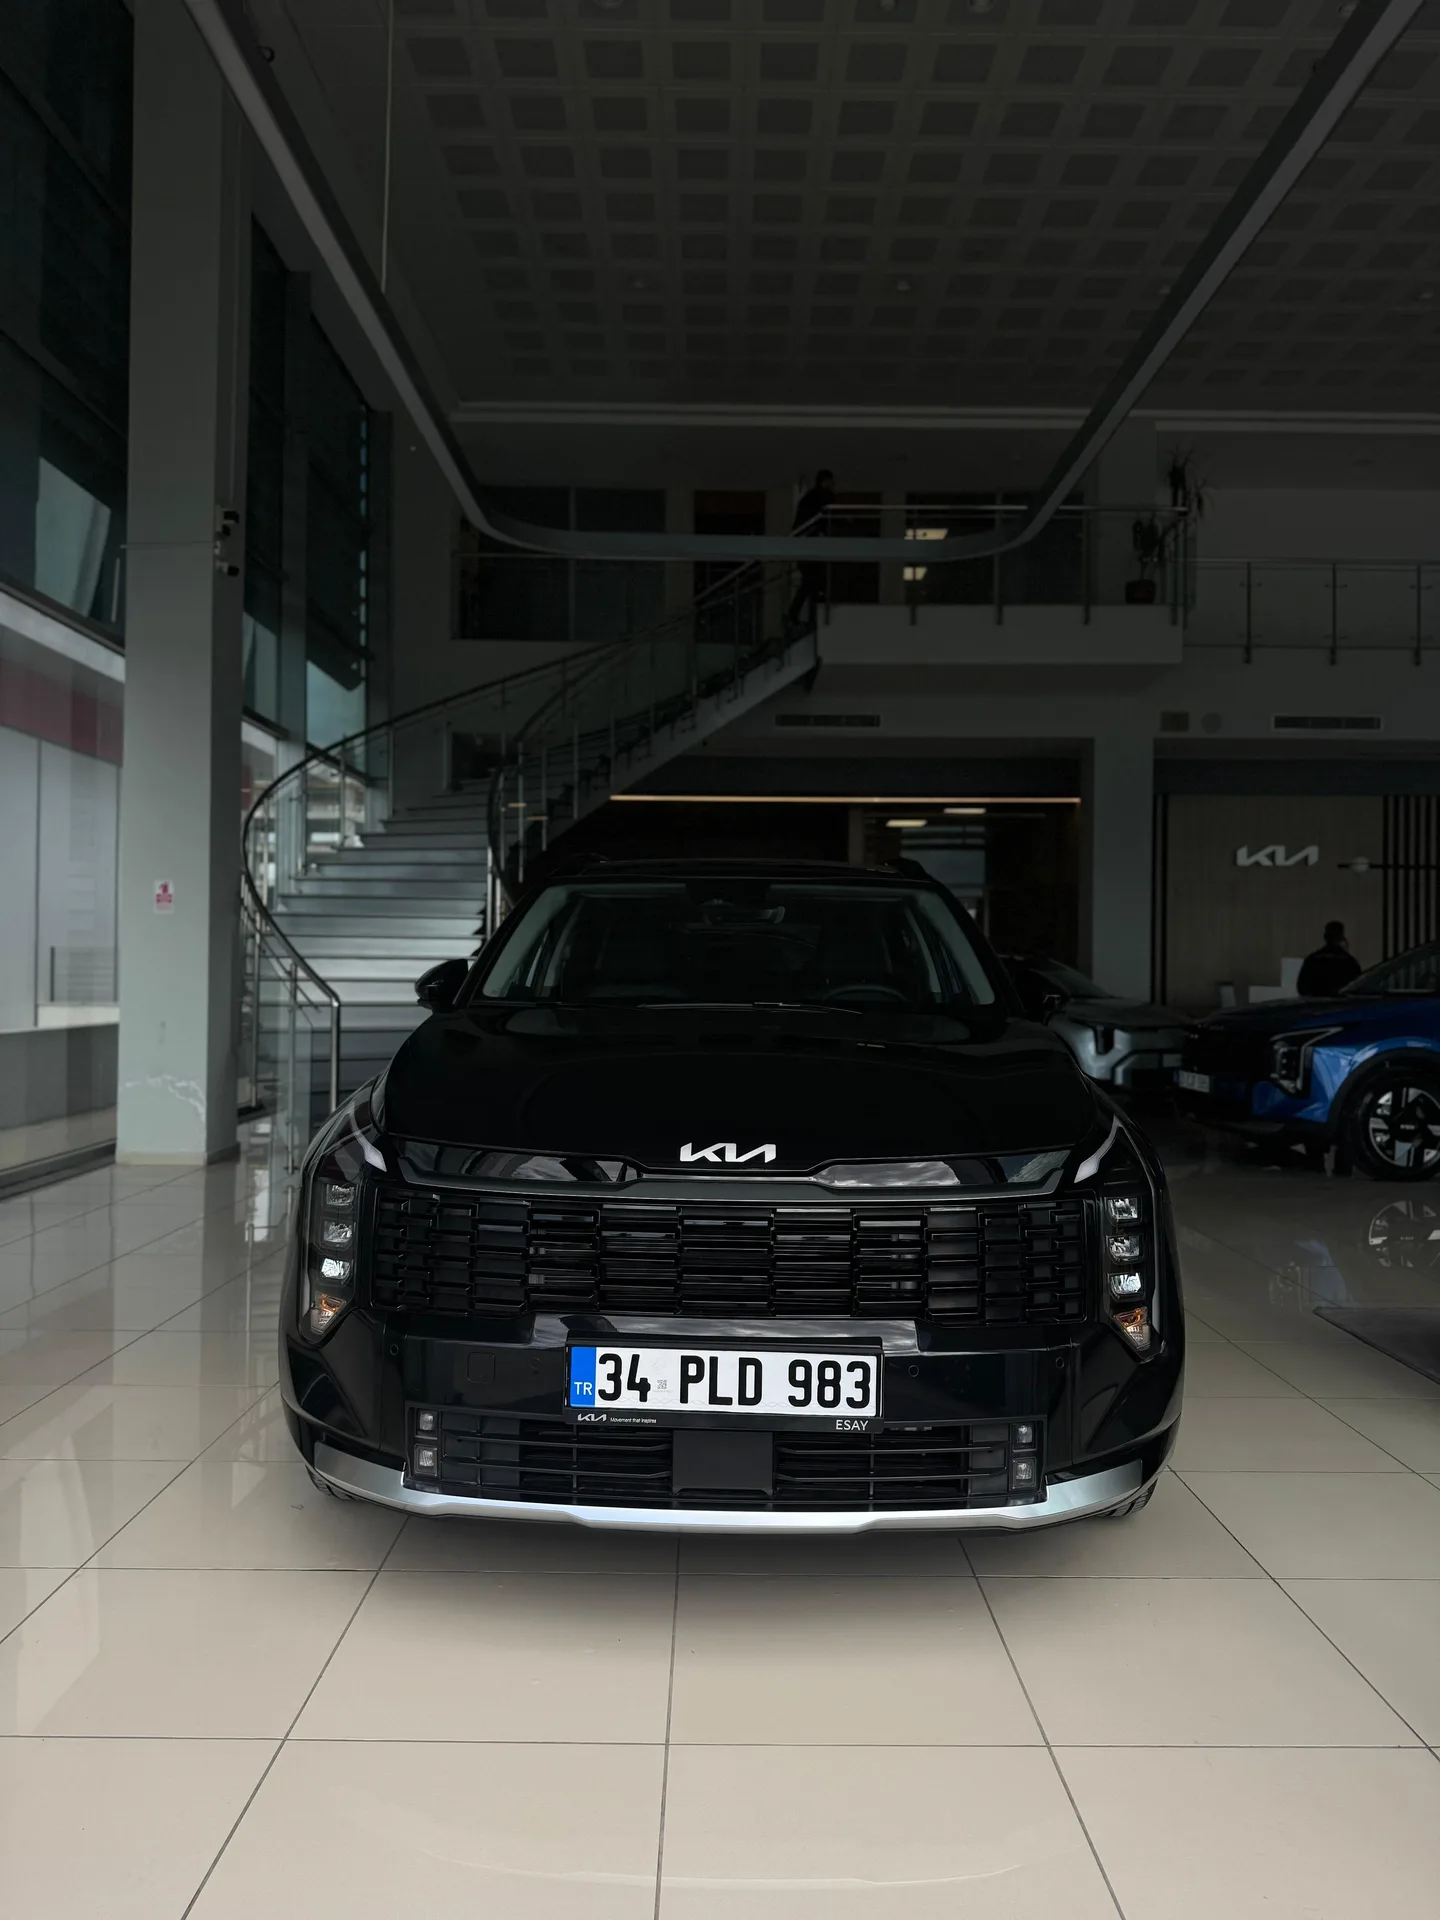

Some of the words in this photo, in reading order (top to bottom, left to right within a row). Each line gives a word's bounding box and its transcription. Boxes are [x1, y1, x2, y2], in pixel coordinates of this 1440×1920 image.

[1235, 844, 1319, 867] KIA
[680, 1142, 776, 1163] KIA
[574, 1381, 593, 1396] TR
[598, 1353, 651, 1402] 34
[680, 1355, 762, 1406] PLD
[788, 1359, 870, 1409] 983
[577, 1413, 607, 1422] KIA
[836, 1420, 869, 1431] ESAY
